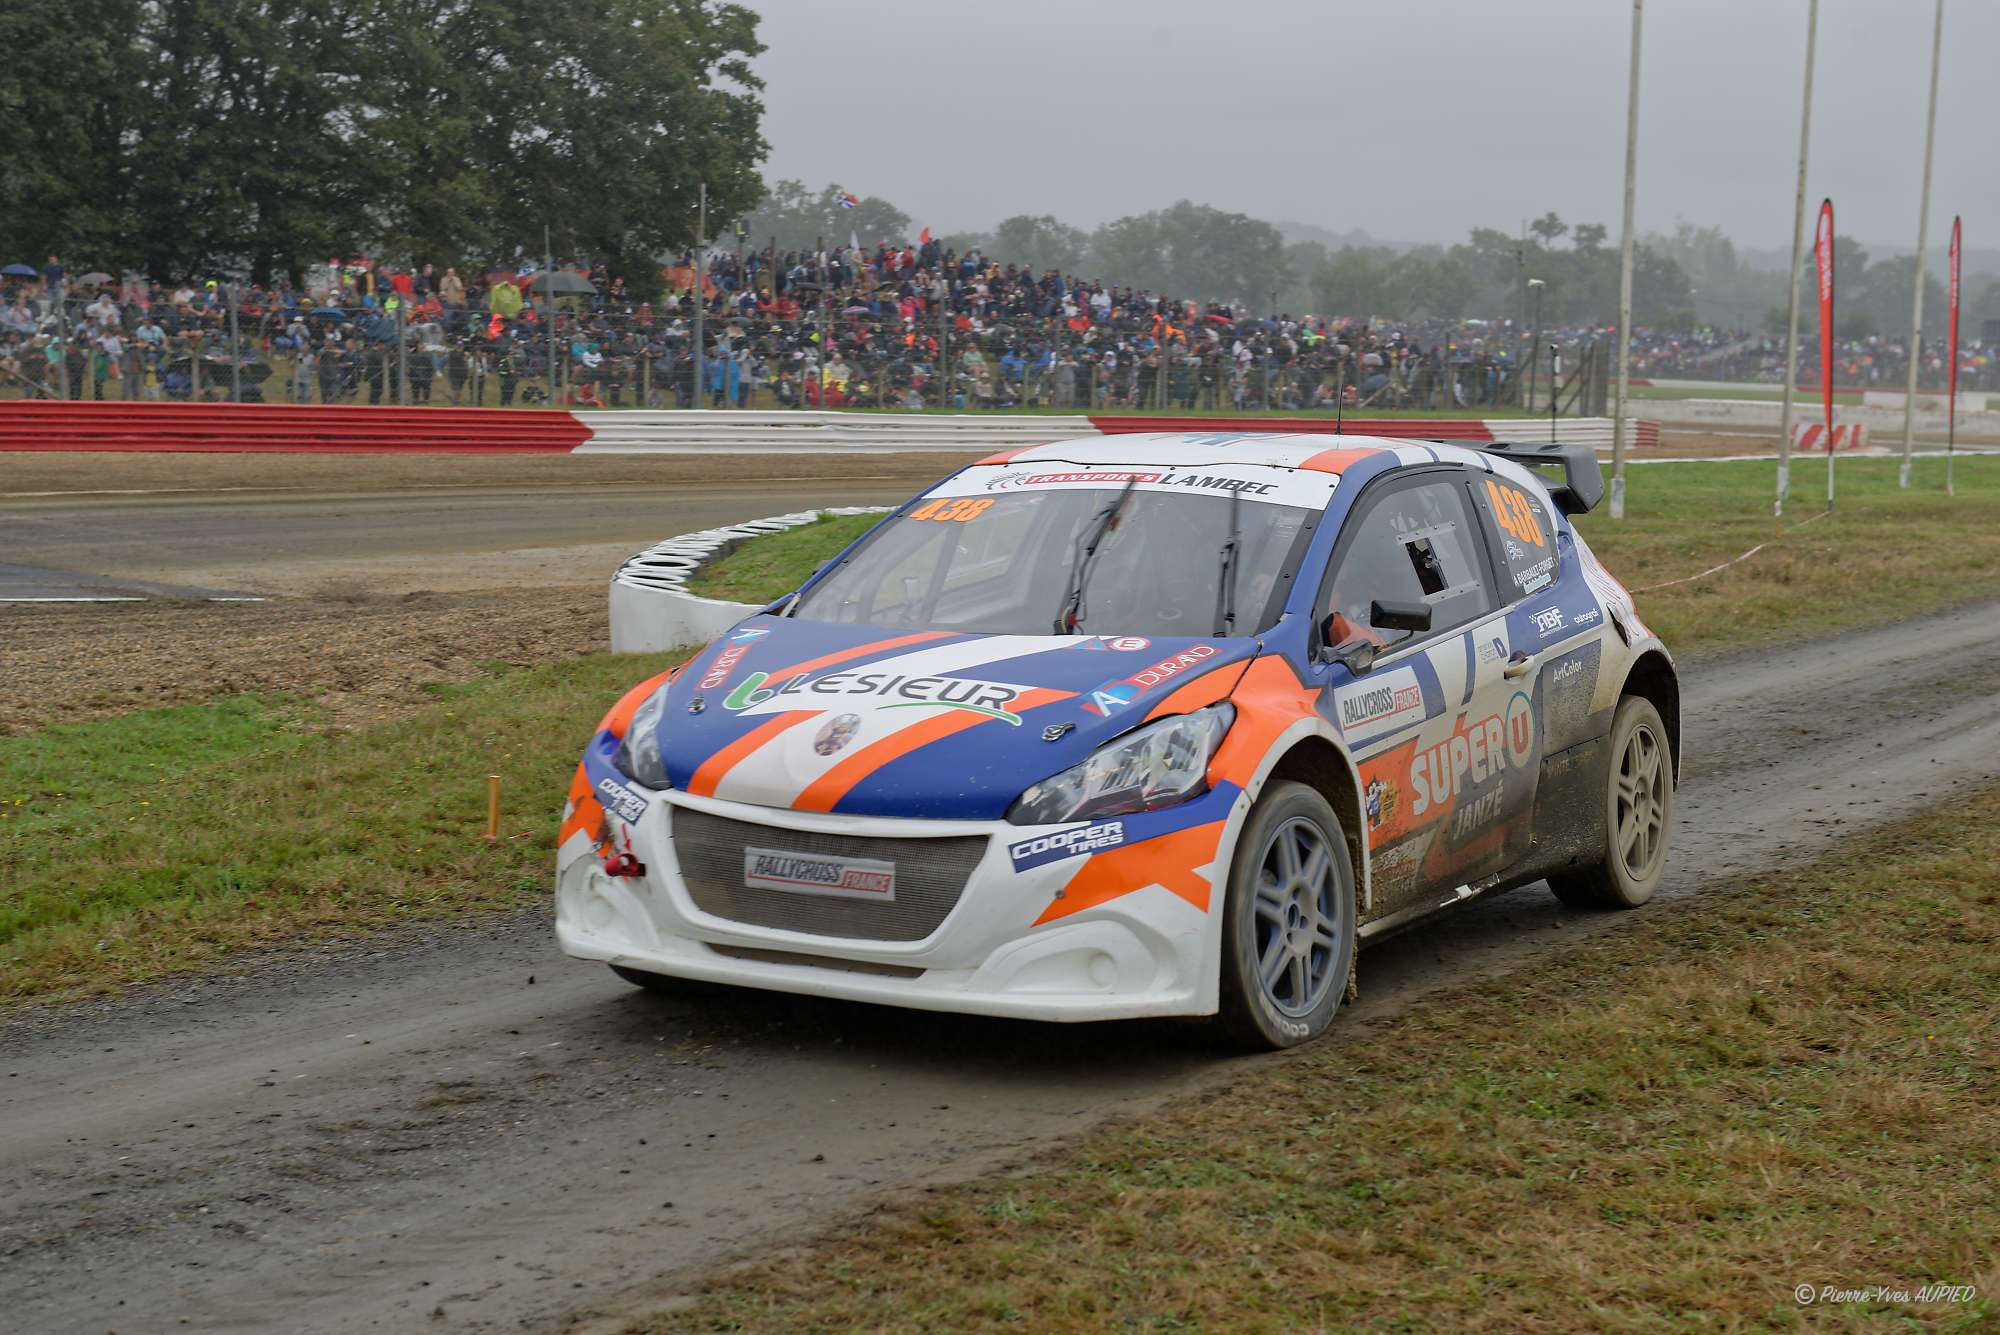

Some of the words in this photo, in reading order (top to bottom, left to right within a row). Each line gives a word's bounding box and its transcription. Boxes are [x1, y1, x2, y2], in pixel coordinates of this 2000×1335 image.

[1032, 473, 1155, 482] TRANSPORTS
[1158, 473, 1279, 496] LAMBEC
[908, 498, 996, 521] 438
[1485, 480, 1544, 546] 438
[1134, 646, 1215, 685] DURAND
[1553, 659, 1581, 683] ArtColor
[778, 672, 1019, 709] LESIEUR
[1344, 686, 1393, 724] RALLYCROSS
[1410, 716, 1506, 815] SUPER
[1511, 711, 1529, 754] U
[598, 778, 647, 812] COOPER
[1453, 779, 1503, 840] JANZÉ
[1012, 821, 1123, 859] COOPER
[1066, 833, 1123, 854] TIRES
[754, 855, 843, 882] RALLYCROSS
